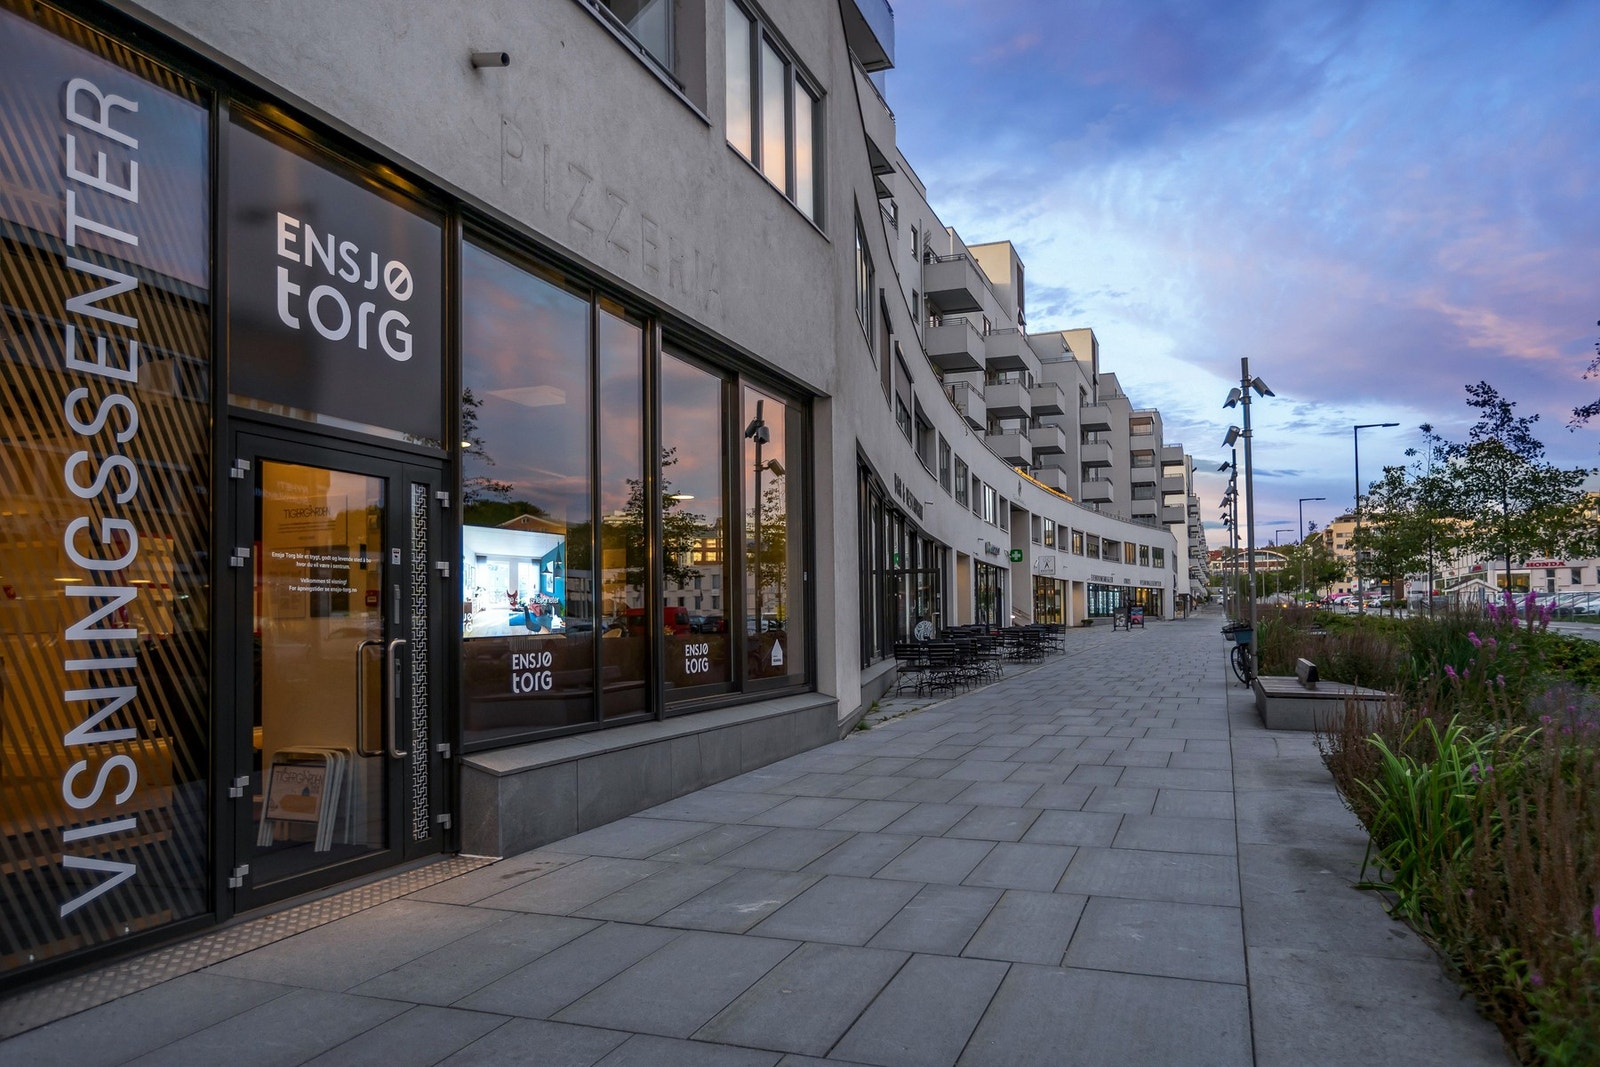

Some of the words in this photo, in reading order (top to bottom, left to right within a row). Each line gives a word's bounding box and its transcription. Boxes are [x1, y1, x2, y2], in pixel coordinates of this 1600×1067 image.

[277, 212, 414, 301] ENSJØ
[61, 78, 139, 917] VISNINGSSENTER
[512, 651, 552, 670] ENSJØ
[685, 643, 709, 656] ENSJØ
